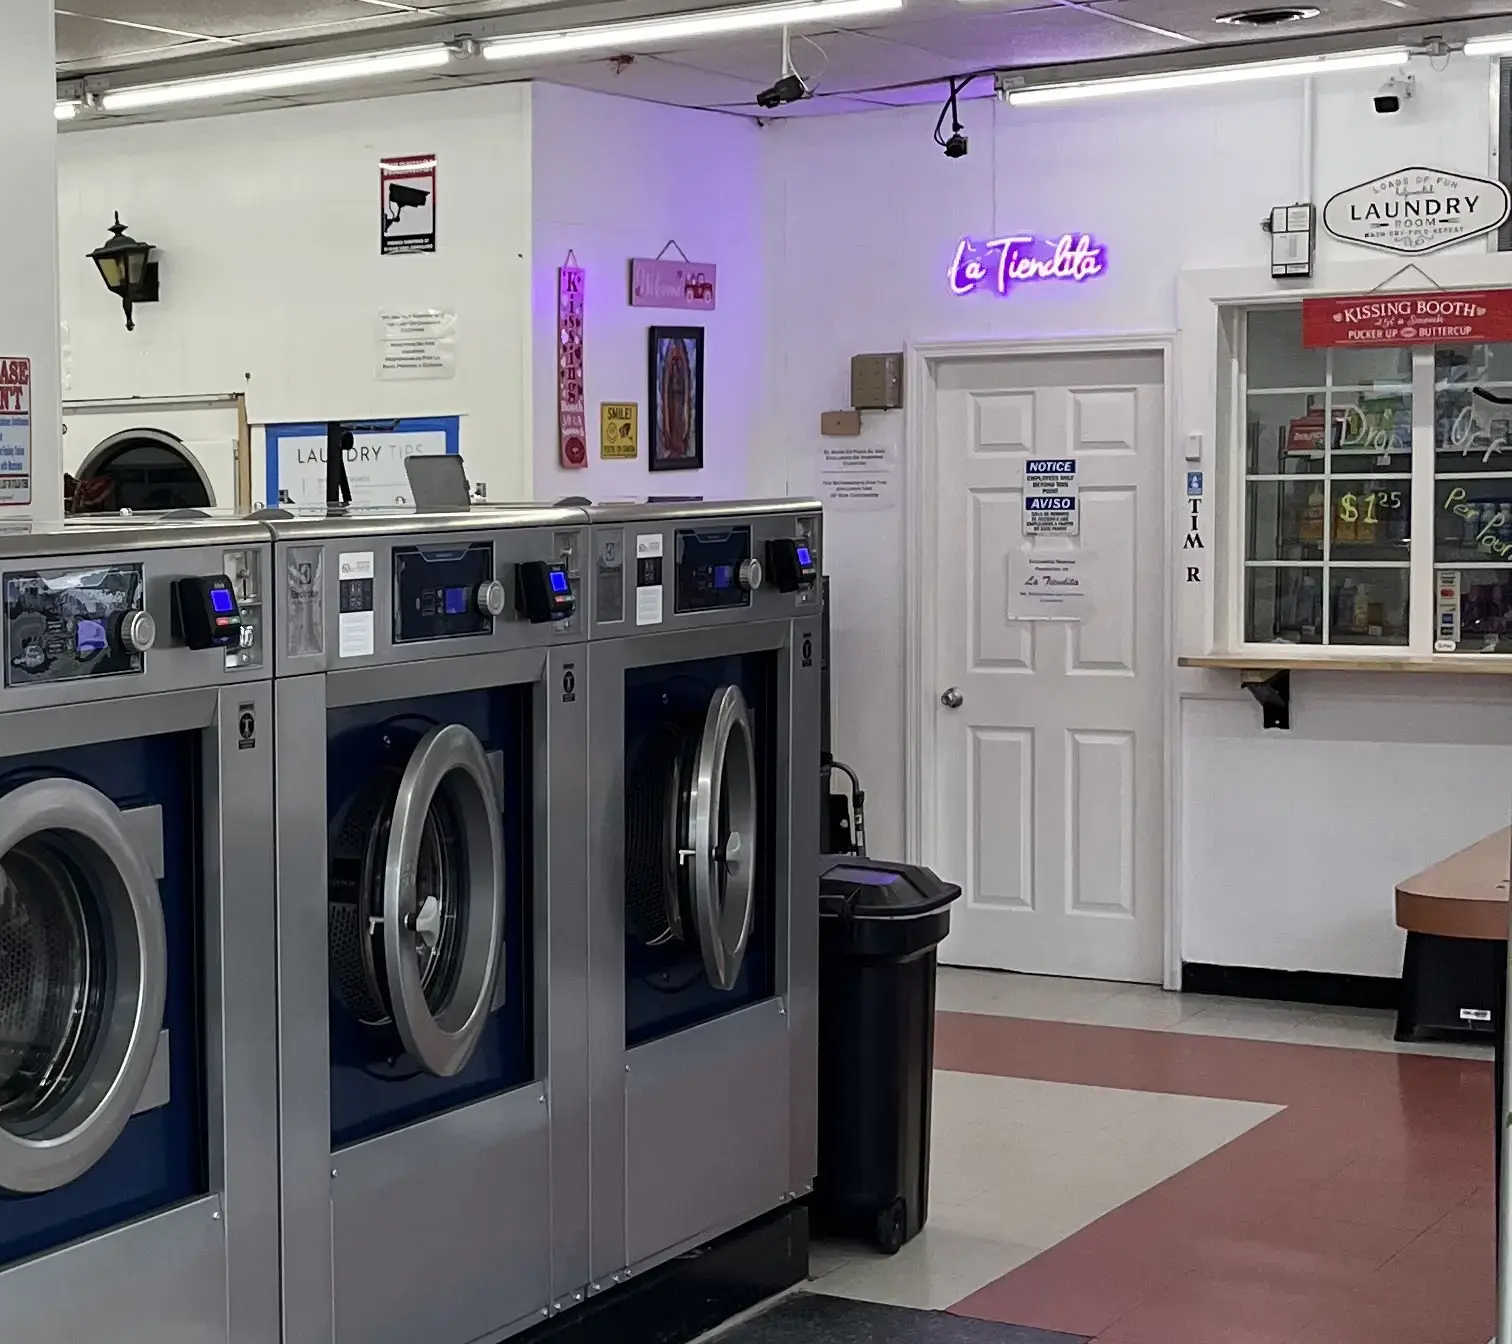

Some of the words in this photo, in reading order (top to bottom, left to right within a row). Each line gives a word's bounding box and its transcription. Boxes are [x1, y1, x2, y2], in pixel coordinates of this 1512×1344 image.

[1372, 177, 1408, 193] LOADS
[1437, 177, 1458, 189] FUN
[1351, 195, 1479, 221] LAUNDRY
[1395, 218, 1436, 228] ROOM
[947, 240, 987, 293] La
[986, 234, 1102, 293] Tiendita
[1345, 301, 1411, 323] KISSING
[1417, 301, 1476, 317] BOOTH
[1348, 330, 1383, 340] PUCKER
[1385, 328, 1398, 338] UP
[1419, 326, 1472, 337] BUTTERCUP
[297, 445, 382, 464] LAUDRY
[1029, 461, 1073, 472] NOTICE
[1030, 498, 1071, 509] AVISO
[1476, 511, 1512, 561] Poun
